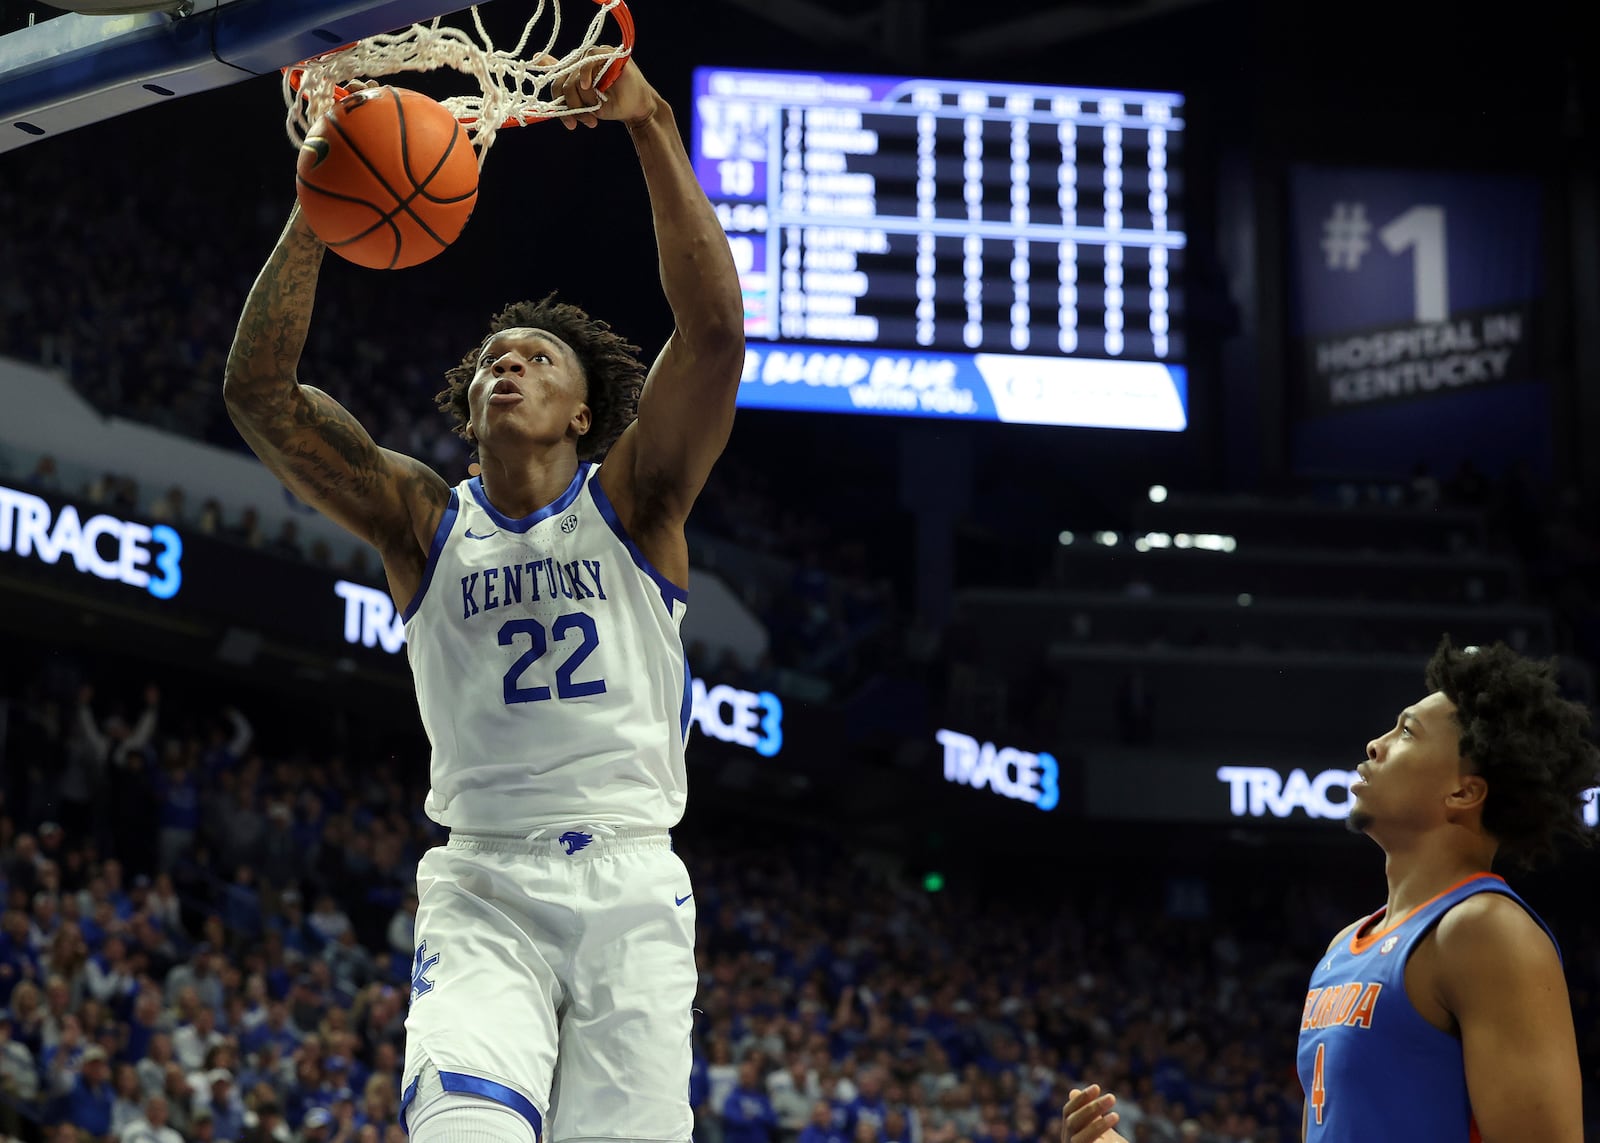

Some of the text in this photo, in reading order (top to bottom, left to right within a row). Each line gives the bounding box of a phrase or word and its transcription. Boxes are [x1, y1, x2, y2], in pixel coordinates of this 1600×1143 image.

[1321, 202, 1448, 325] #1
[1316, 312, 1522, 373] HOSPITAL IN
[1330, 349, 1512, 404] KENTUCKY
[461, 558, 607, 620] KENTUCKY
[498, 612, 607, 704] 22
[936, 728, 1059, 811] TRACE3
[1311, 1042, 1326, 1125] 4
